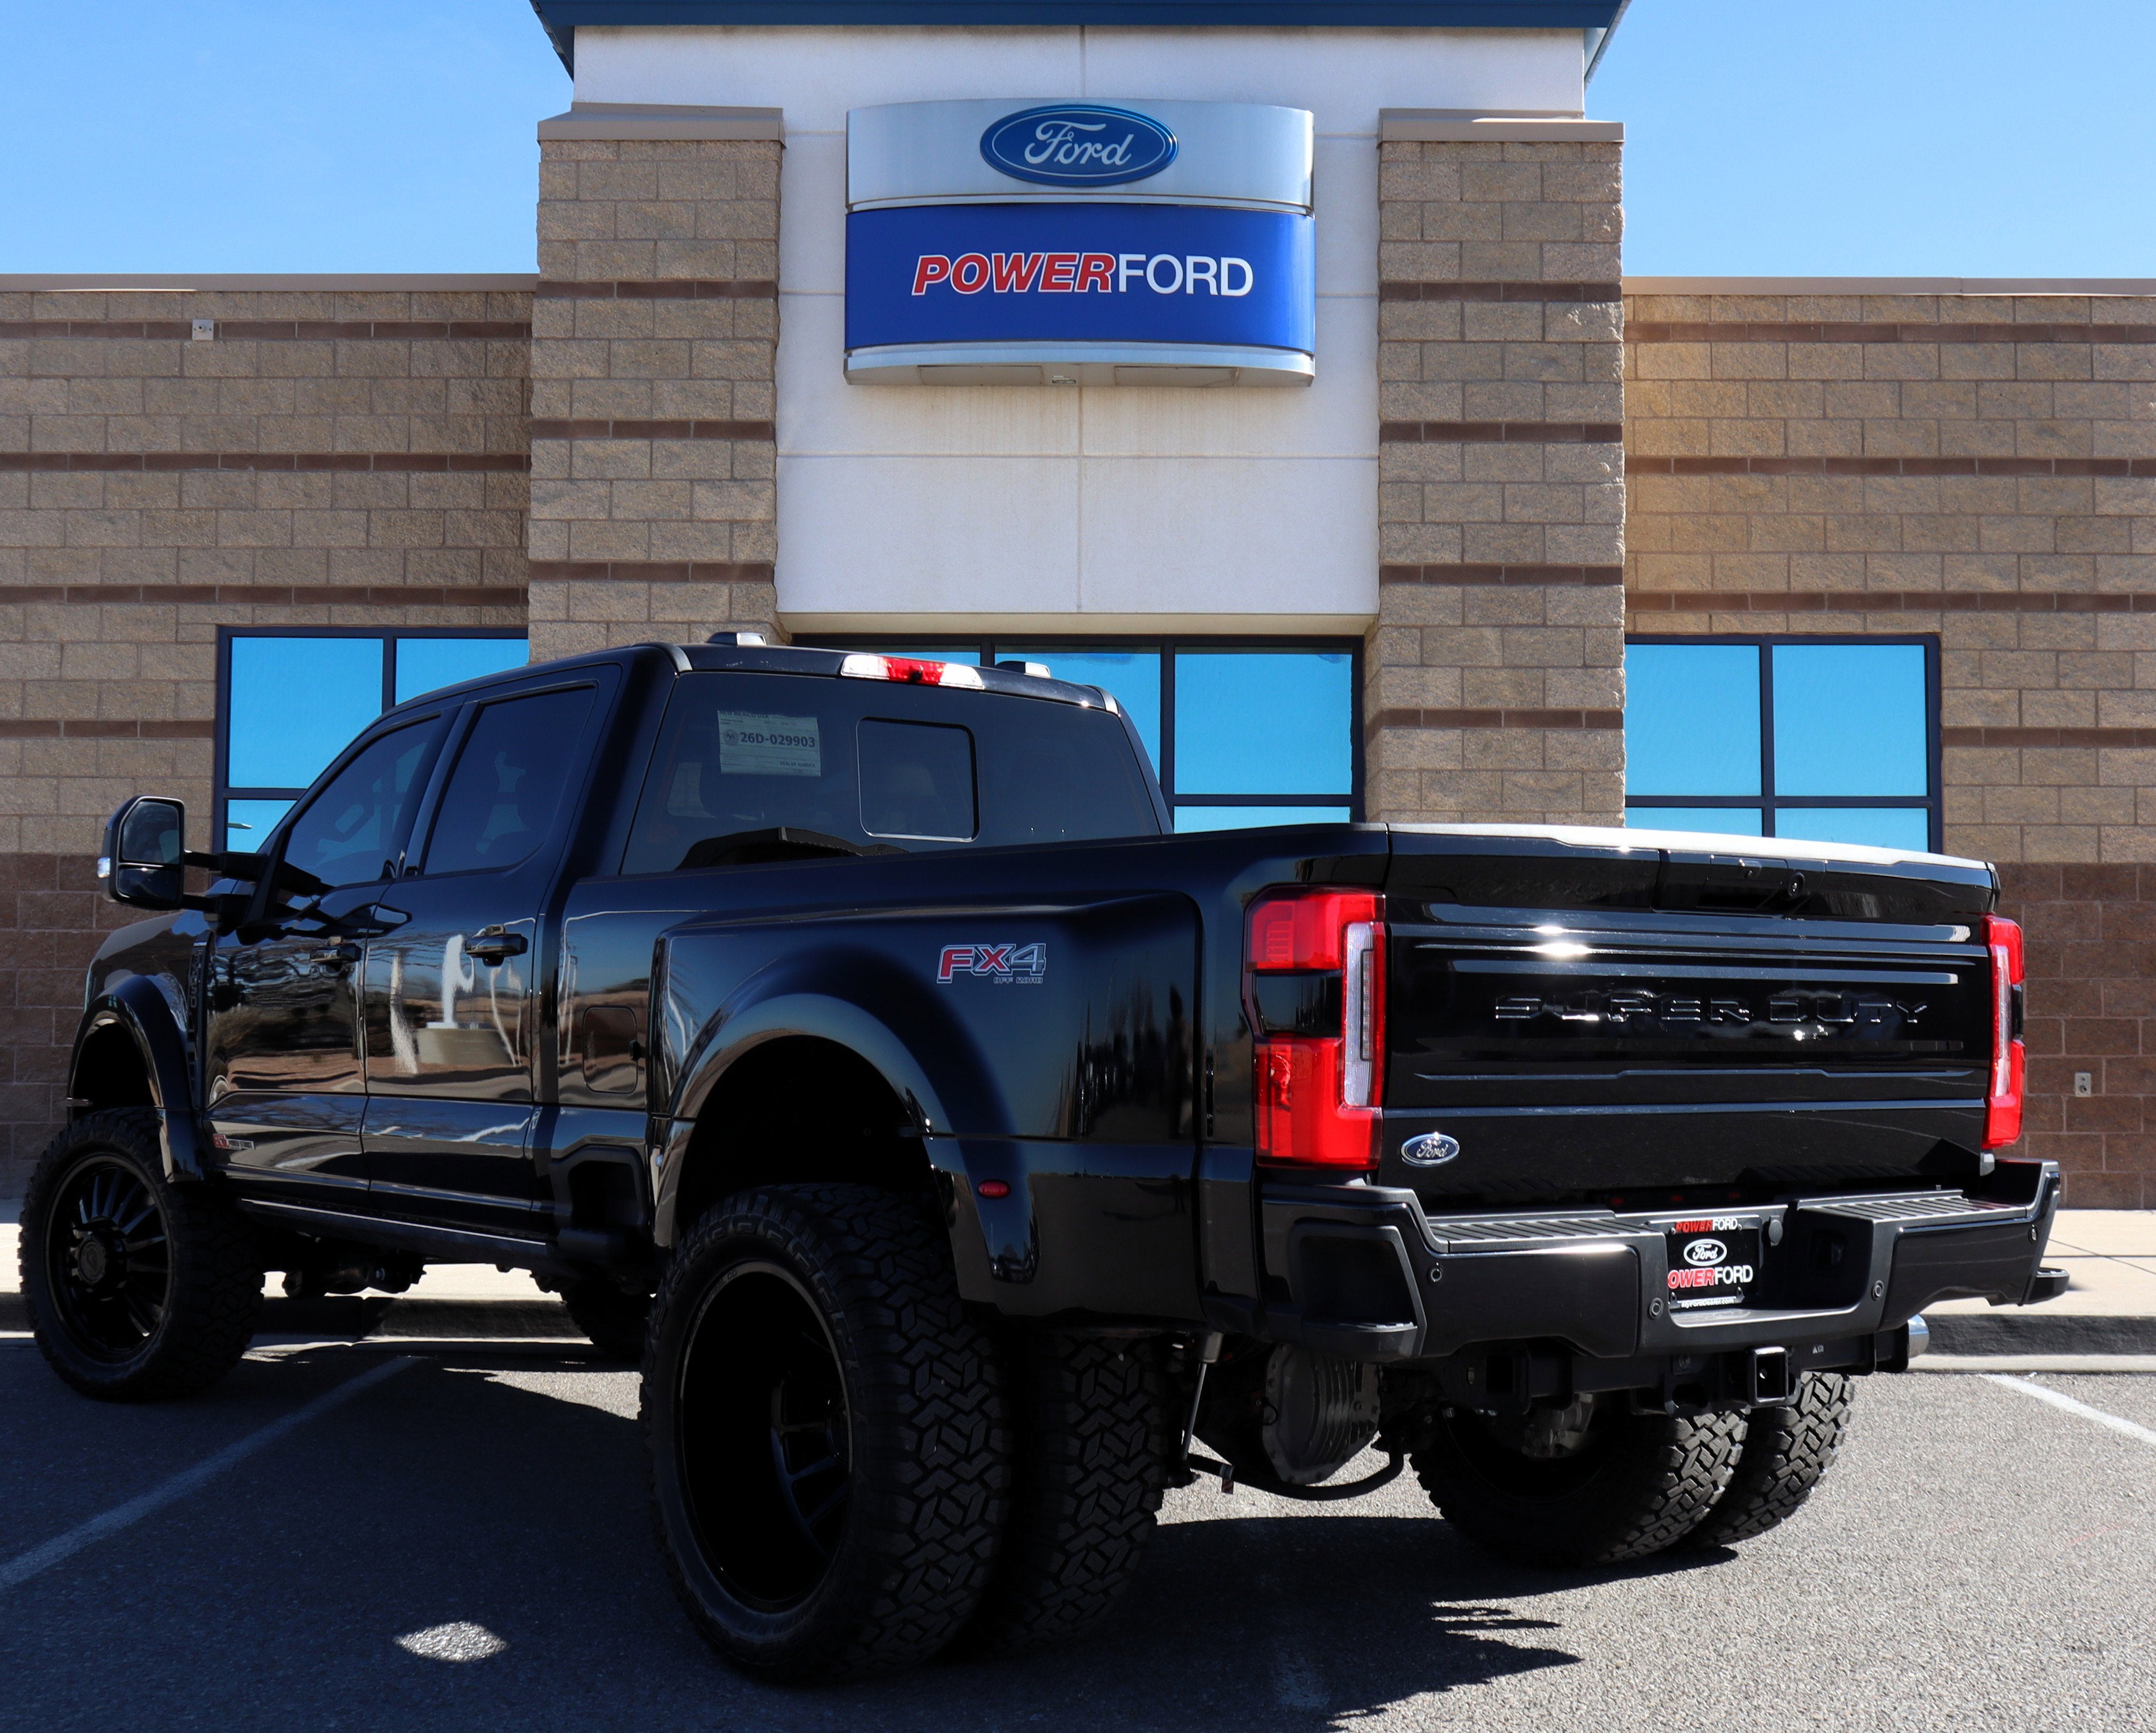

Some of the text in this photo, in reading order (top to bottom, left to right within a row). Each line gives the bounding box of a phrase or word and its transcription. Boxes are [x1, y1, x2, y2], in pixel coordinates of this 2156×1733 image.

[1024, 120, 1134, 166] Ford
[912, 252, 1254, 297] POWERFORD
[740, 732, 815, 747] 26D-029903
[937, 943, 1046, 983] FX4
[1494, 994, 1928, 1024] SUPER DUTY
[1416, 1140, 1449, 1158] Ford
[1675, 1218, 1739, 1233] POWERFORD
[1692, 1243, 1718, 1260] Ford
[1668, 1265, 1753, 1290] OWERFORD
